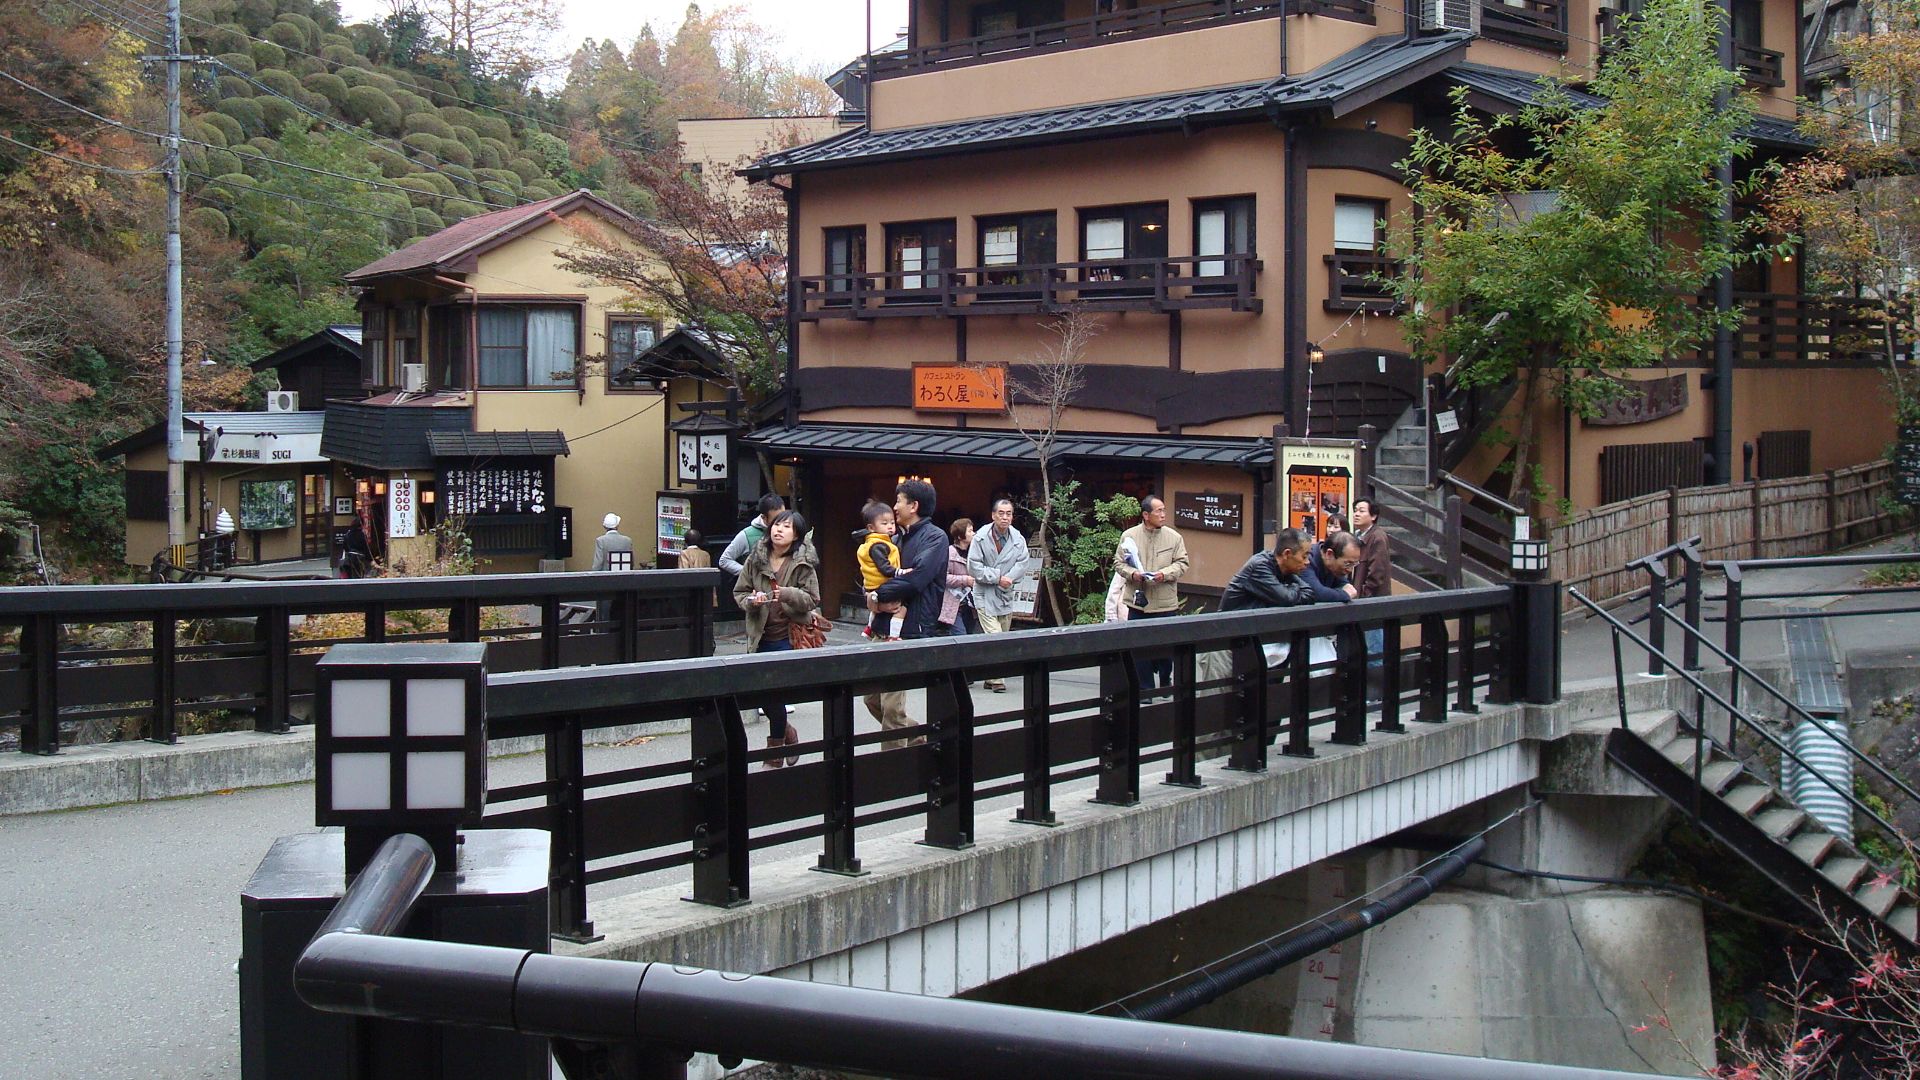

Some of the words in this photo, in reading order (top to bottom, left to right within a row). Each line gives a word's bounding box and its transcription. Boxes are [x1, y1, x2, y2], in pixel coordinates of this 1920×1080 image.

[920, 384, 970, 403] わろく屋
[272, 450, 291, 460] SUGI
[1308, 959, 1324, 974] 20
